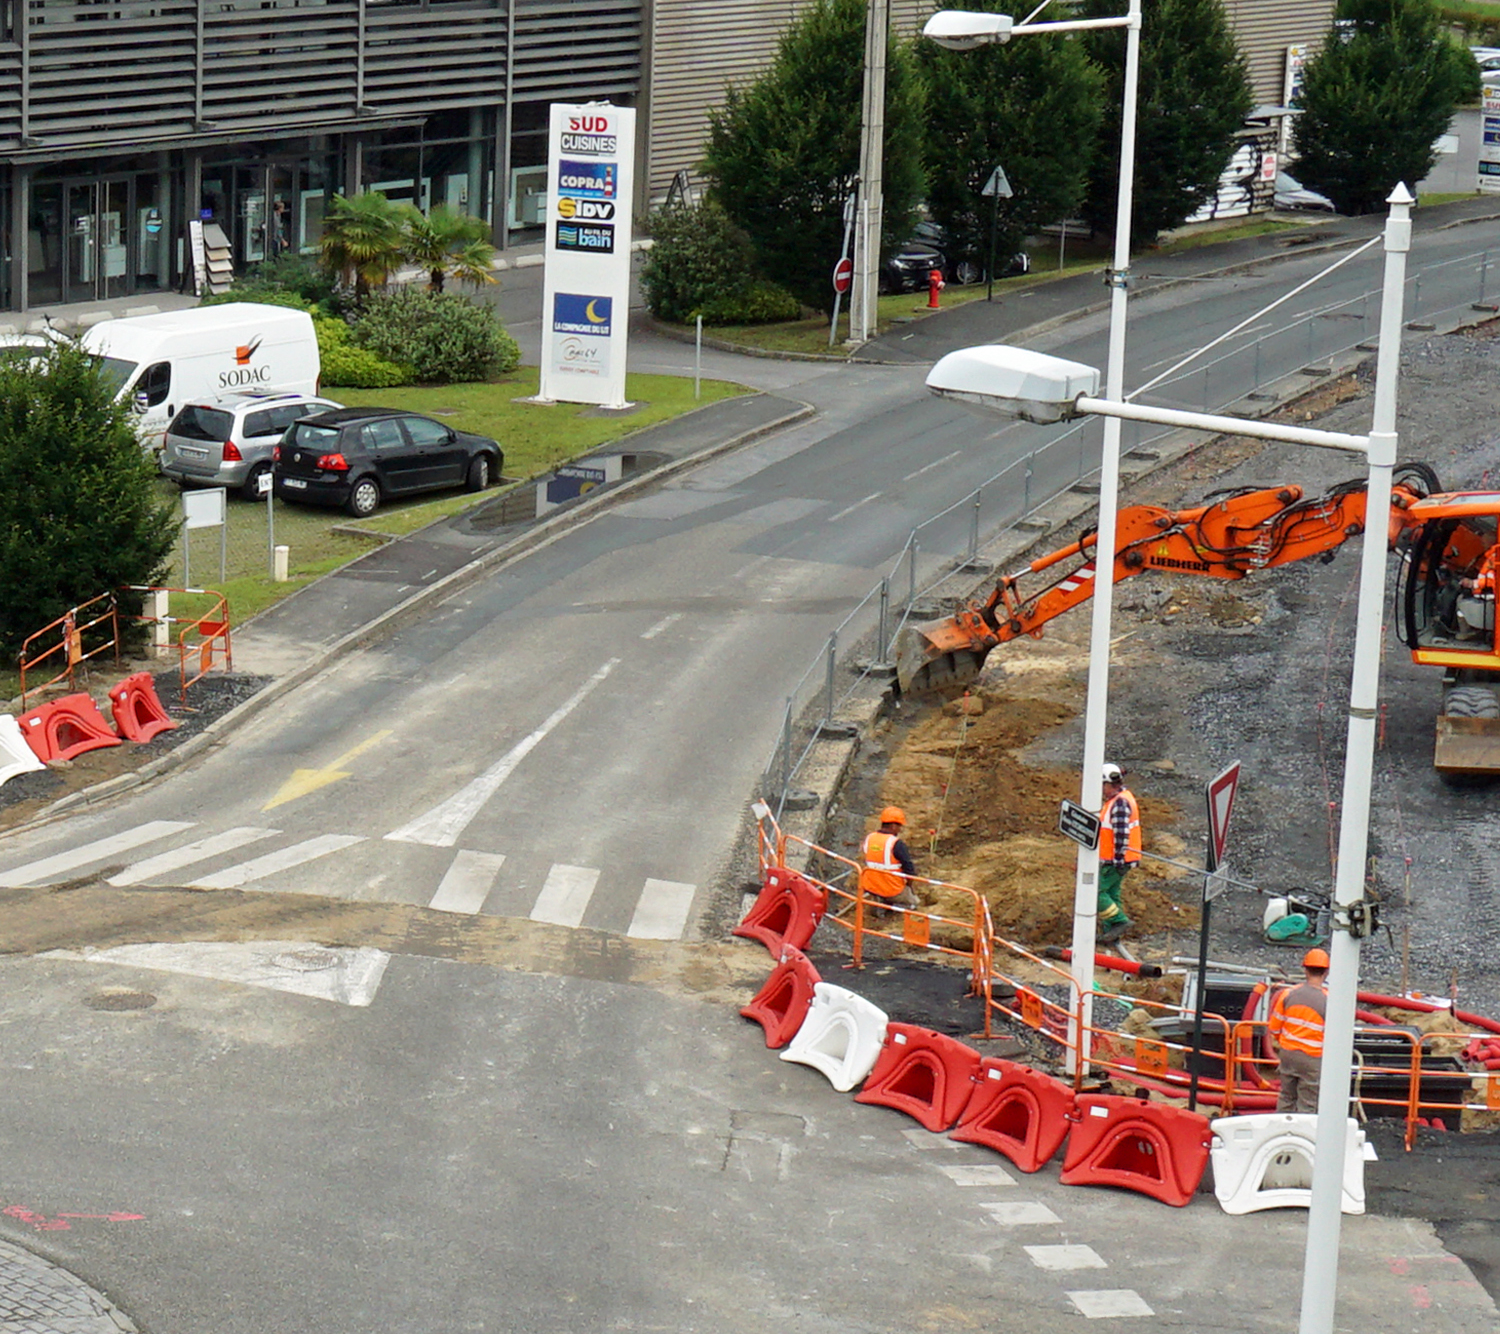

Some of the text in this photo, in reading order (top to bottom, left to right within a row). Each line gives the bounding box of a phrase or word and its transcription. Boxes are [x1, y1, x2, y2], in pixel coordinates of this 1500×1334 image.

[569, 116, 608, 133] SUD
[561, 134, 616, 153] CUISINES
[560, 175, 604, 190] COPRA
[578, 228, 611, 248] bain
[218, 365, 271, 388] SODAC
